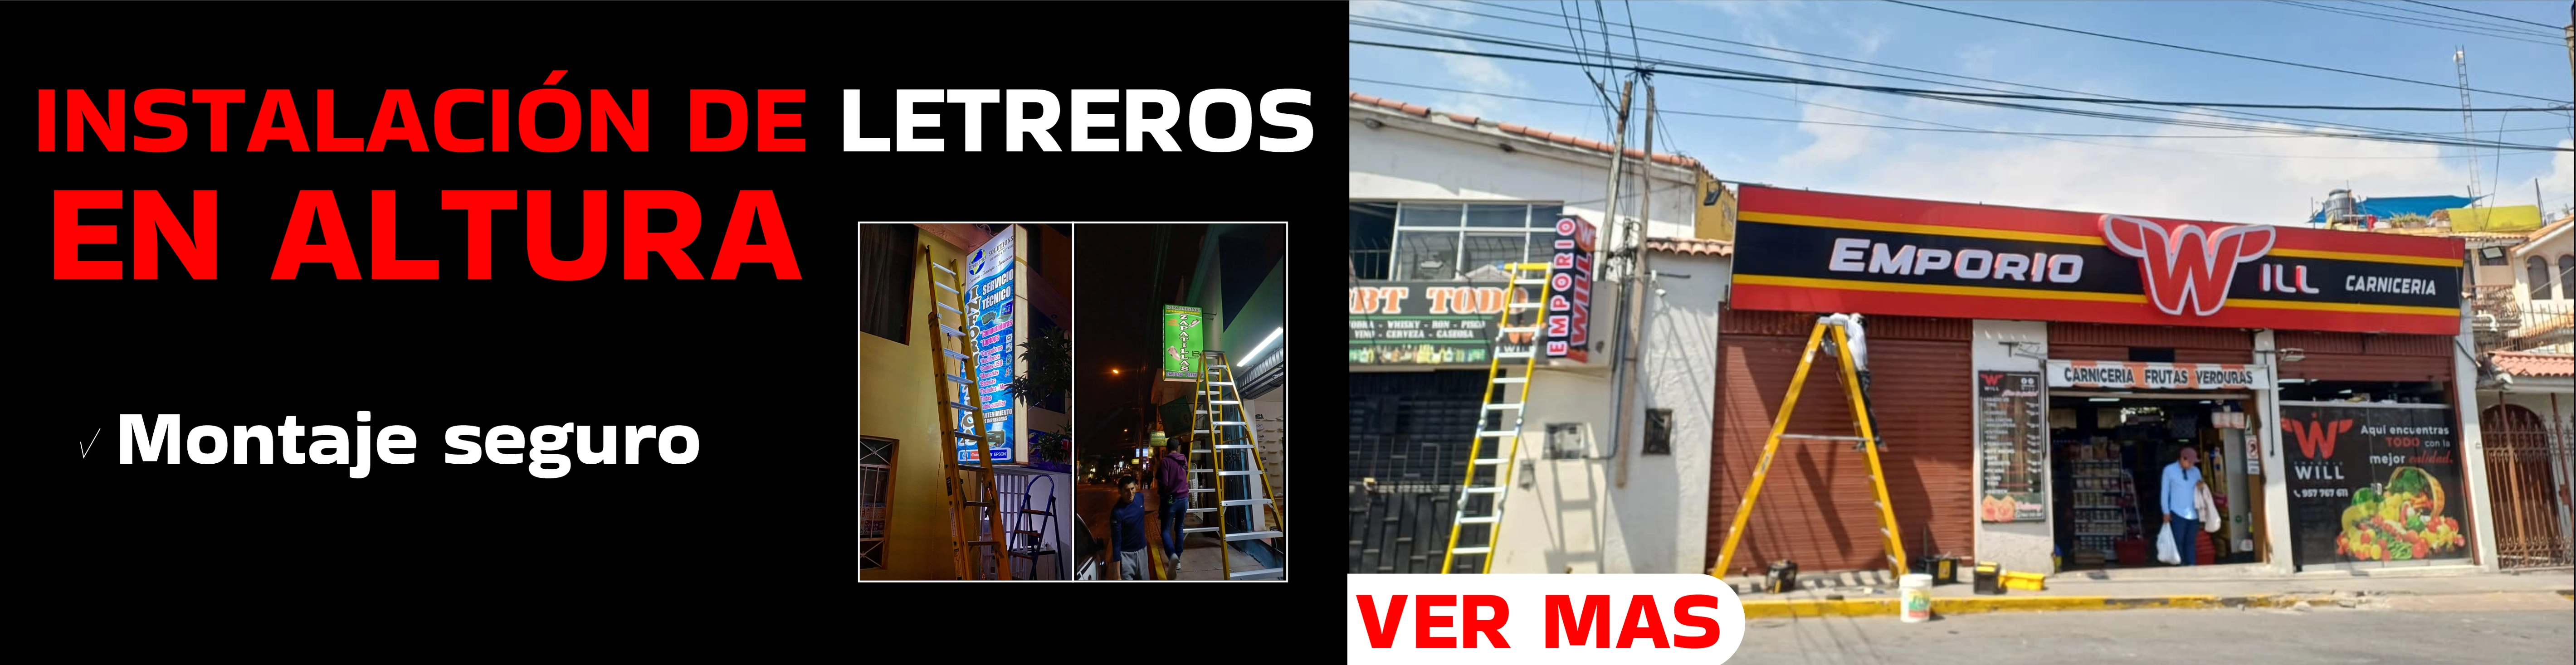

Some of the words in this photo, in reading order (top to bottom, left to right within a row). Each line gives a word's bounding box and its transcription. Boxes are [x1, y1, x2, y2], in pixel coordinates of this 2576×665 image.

[988, 236, 1014, 257] SOLUTIONS
[1829, 238, 2084, 284] EMPORIO
[2345, 275, 2436, 296] CARNICERIA
[982, 268, 1013, 295] SERVICIO
[1546, 218, 1576, 355] EMPORIO
[982, 286, 1011, 310] TÉCNICO
[1426, 287, 1528, 314] TODO
[1571, 252, 1591, 346] WILL
[1386, 330, 1425, 338] CERVEZA
[1436, 330, 1473, 338] GASEOSA
[1387, 320, 1420, 329] WHISKY
[1461, 320, 1485, 329] PISCO
[1179, 315, 1190, 371] ZAPATILLAS
[2064, 367, 2134, 383] CARNICERIA
[2145, 369, 2188, 384] FRUTAS
[2196, 370, 2253, 384] VERDURAS
[2390, 426, 2449, 435] encuentras
[2386, 437, 2420, 447] TODO
[2369, 454, 2405, 466] mejor
[2294, 465, 2345, 480] WILL
